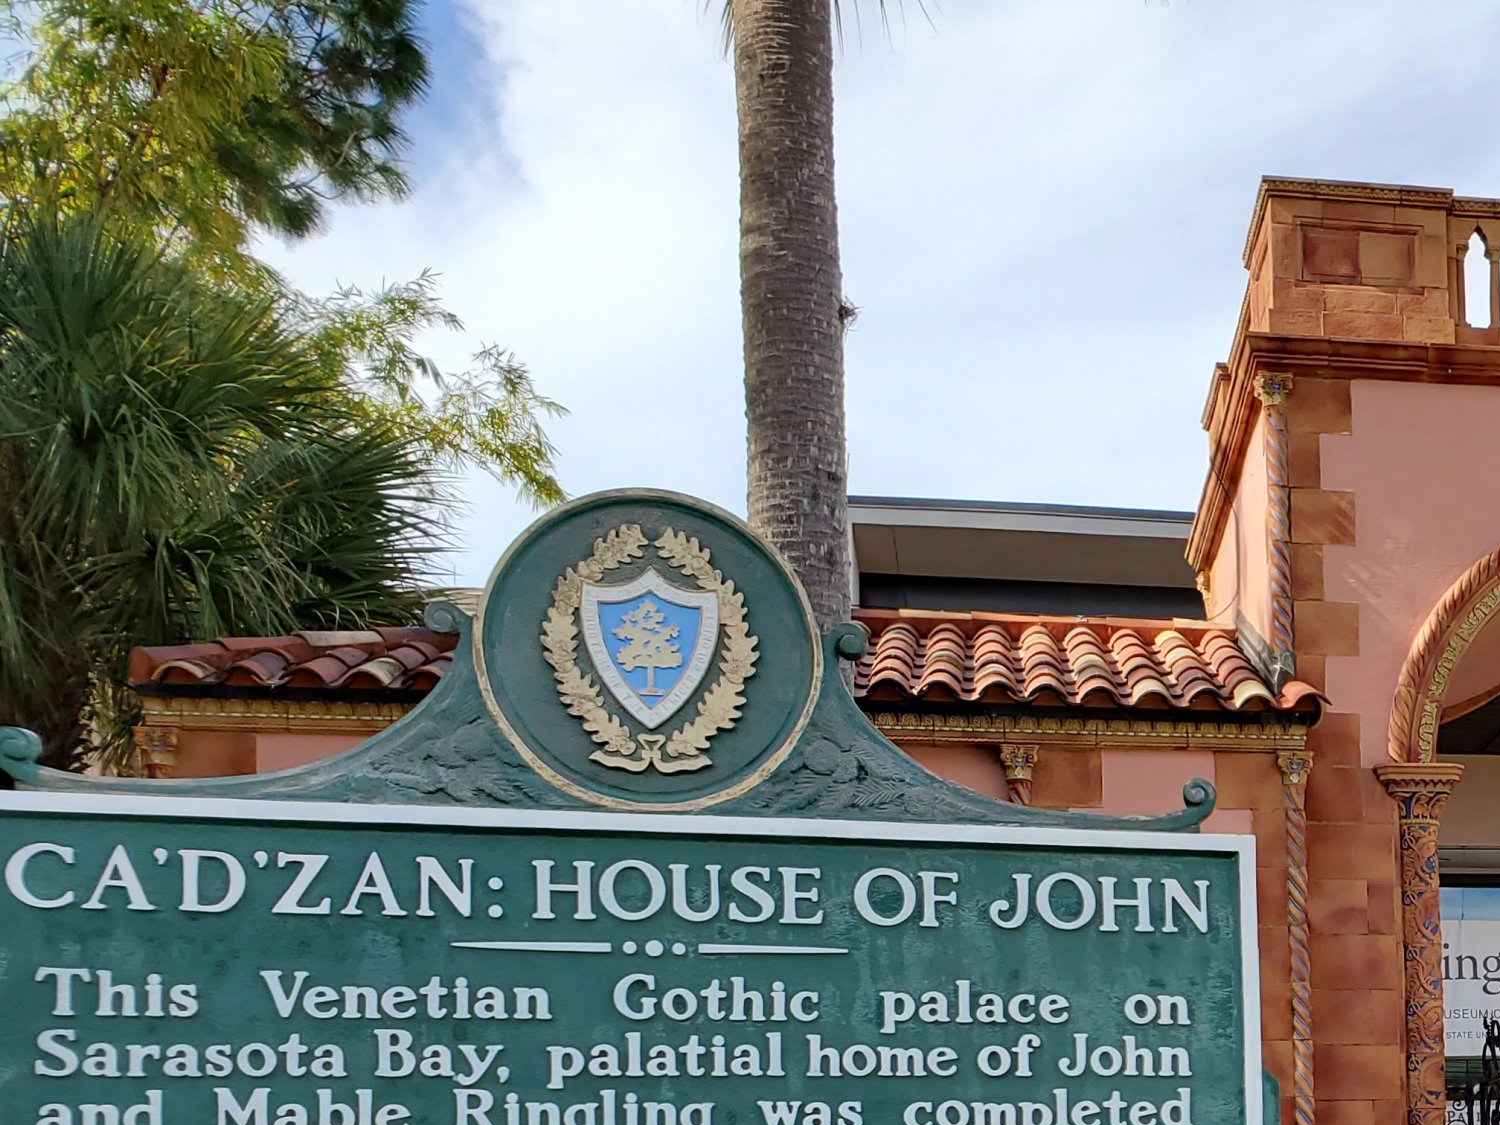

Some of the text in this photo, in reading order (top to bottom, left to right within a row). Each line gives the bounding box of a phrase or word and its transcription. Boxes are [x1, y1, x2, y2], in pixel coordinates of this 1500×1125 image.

[532, 860, 823, 923] HOUSE
[854, 868, 957, 926] OF
[990, 873, 1209, 932] JOHN
[36, 967, 1190, 1033] This Venetian Gothic palace on
[1443, 1008, 1489, 1019] USEUM
[36, 1029, 1192, 1088] Sarasota Bay, palatial home of John
[1445, 1031, 1474, 1039] STATE
